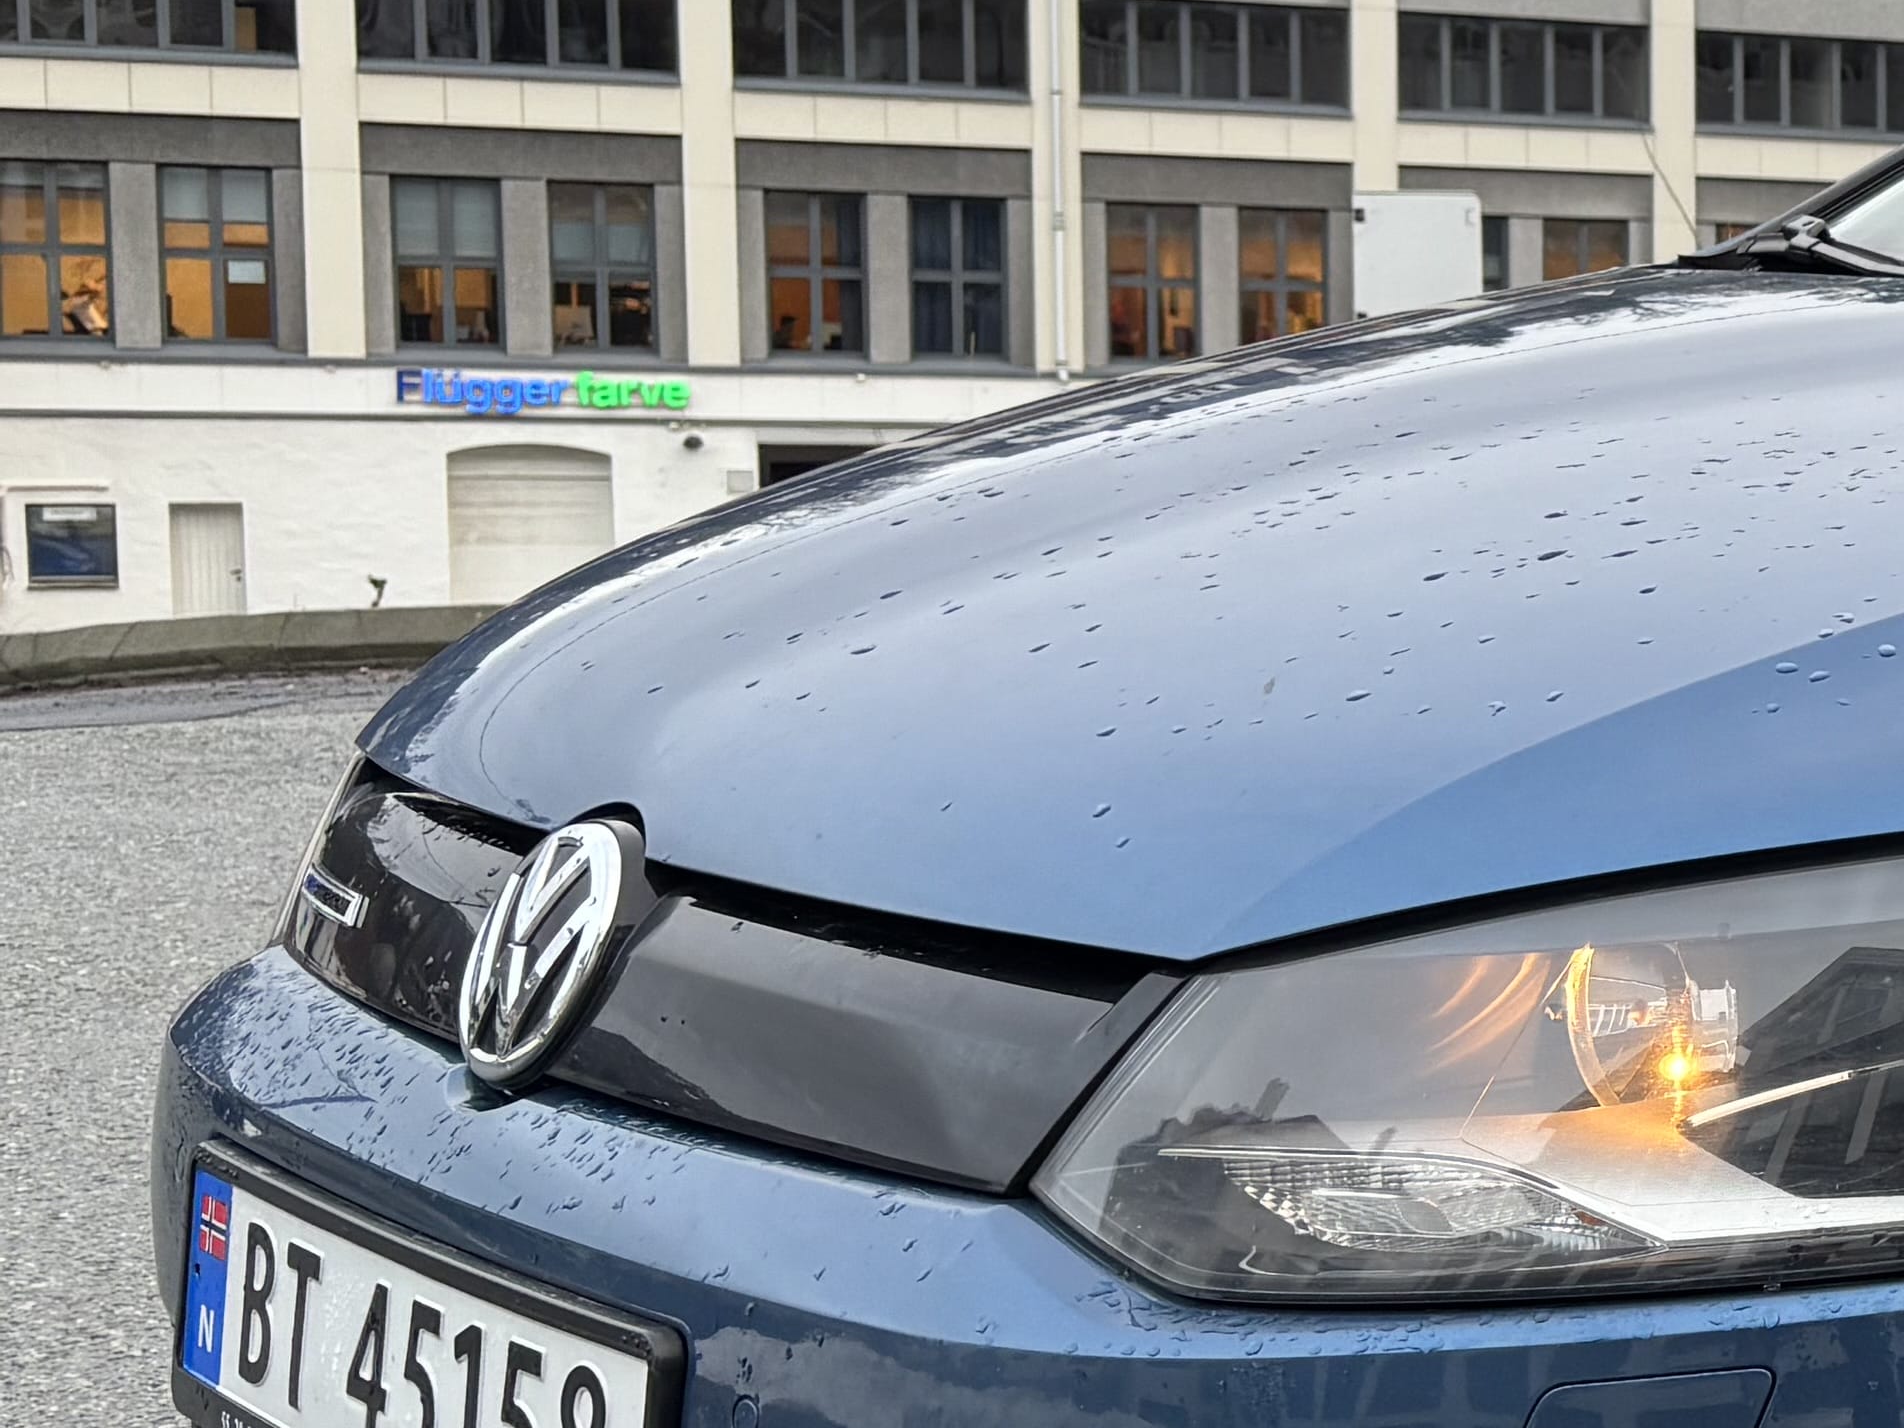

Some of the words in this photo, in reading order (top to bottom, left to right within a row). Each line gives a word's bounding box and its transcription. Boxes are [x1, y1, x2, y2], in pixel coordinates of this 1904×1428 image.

[396, 368, 570, 414] Flügger
[573, 371, 691, 410] farve
[196, 1303, 215, 1354] N
[237, 1220, 322, 1410] BT
